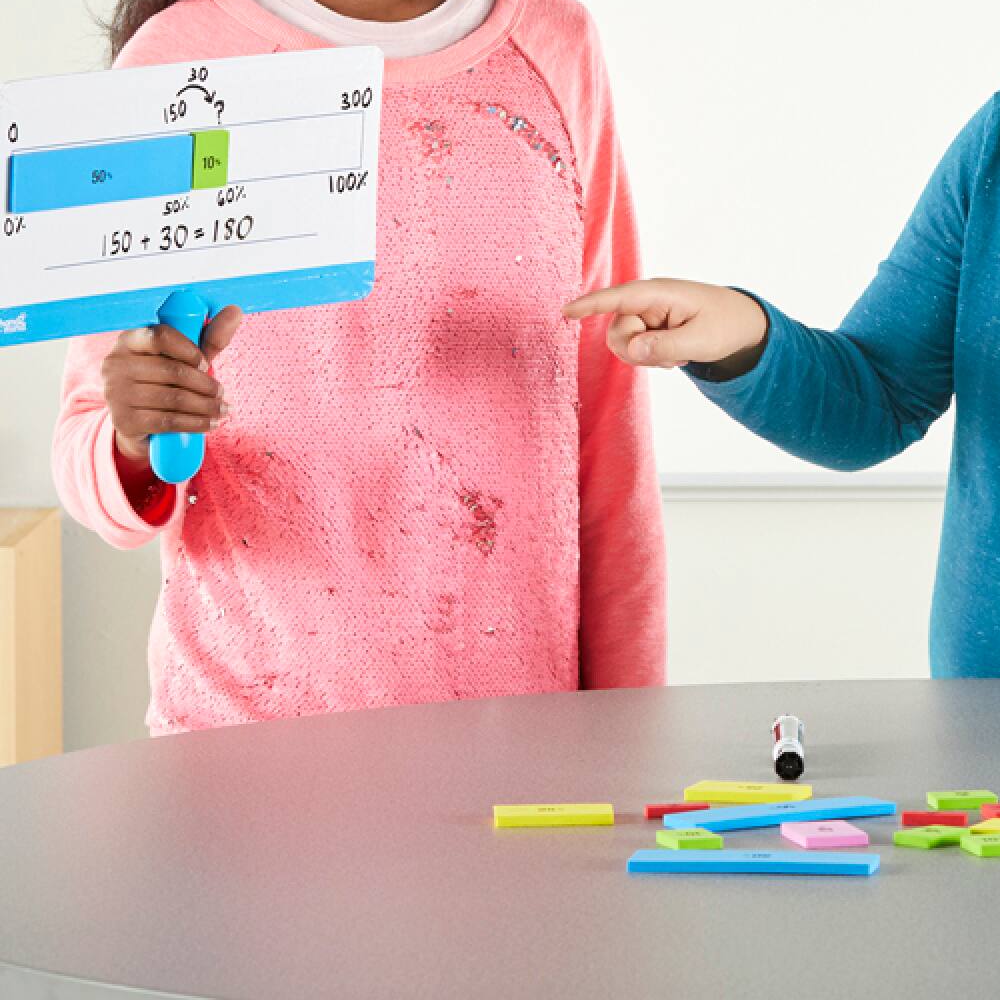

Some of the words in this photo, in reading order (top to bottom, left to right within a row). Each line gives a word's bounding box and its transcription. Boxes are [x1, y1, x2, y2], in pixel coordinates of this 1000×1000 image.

[187, 67, 209, 83] 30
[340, 87, 373, 111] 300
[163, 99, 187, 124] 150
[213, 99, 225, 125] ?
[7, 121, 19, 143] 0
[328, 171, 369, 194] 100%
[162, 196, 190, 216] 50%
[216, 185, 247, 207] 60%
[3, 215, 27, 237] 0%
[101, 229, 133, 257] 150
[159, 224, 189, 251] 30
[212, 214, 254, 243] 180
